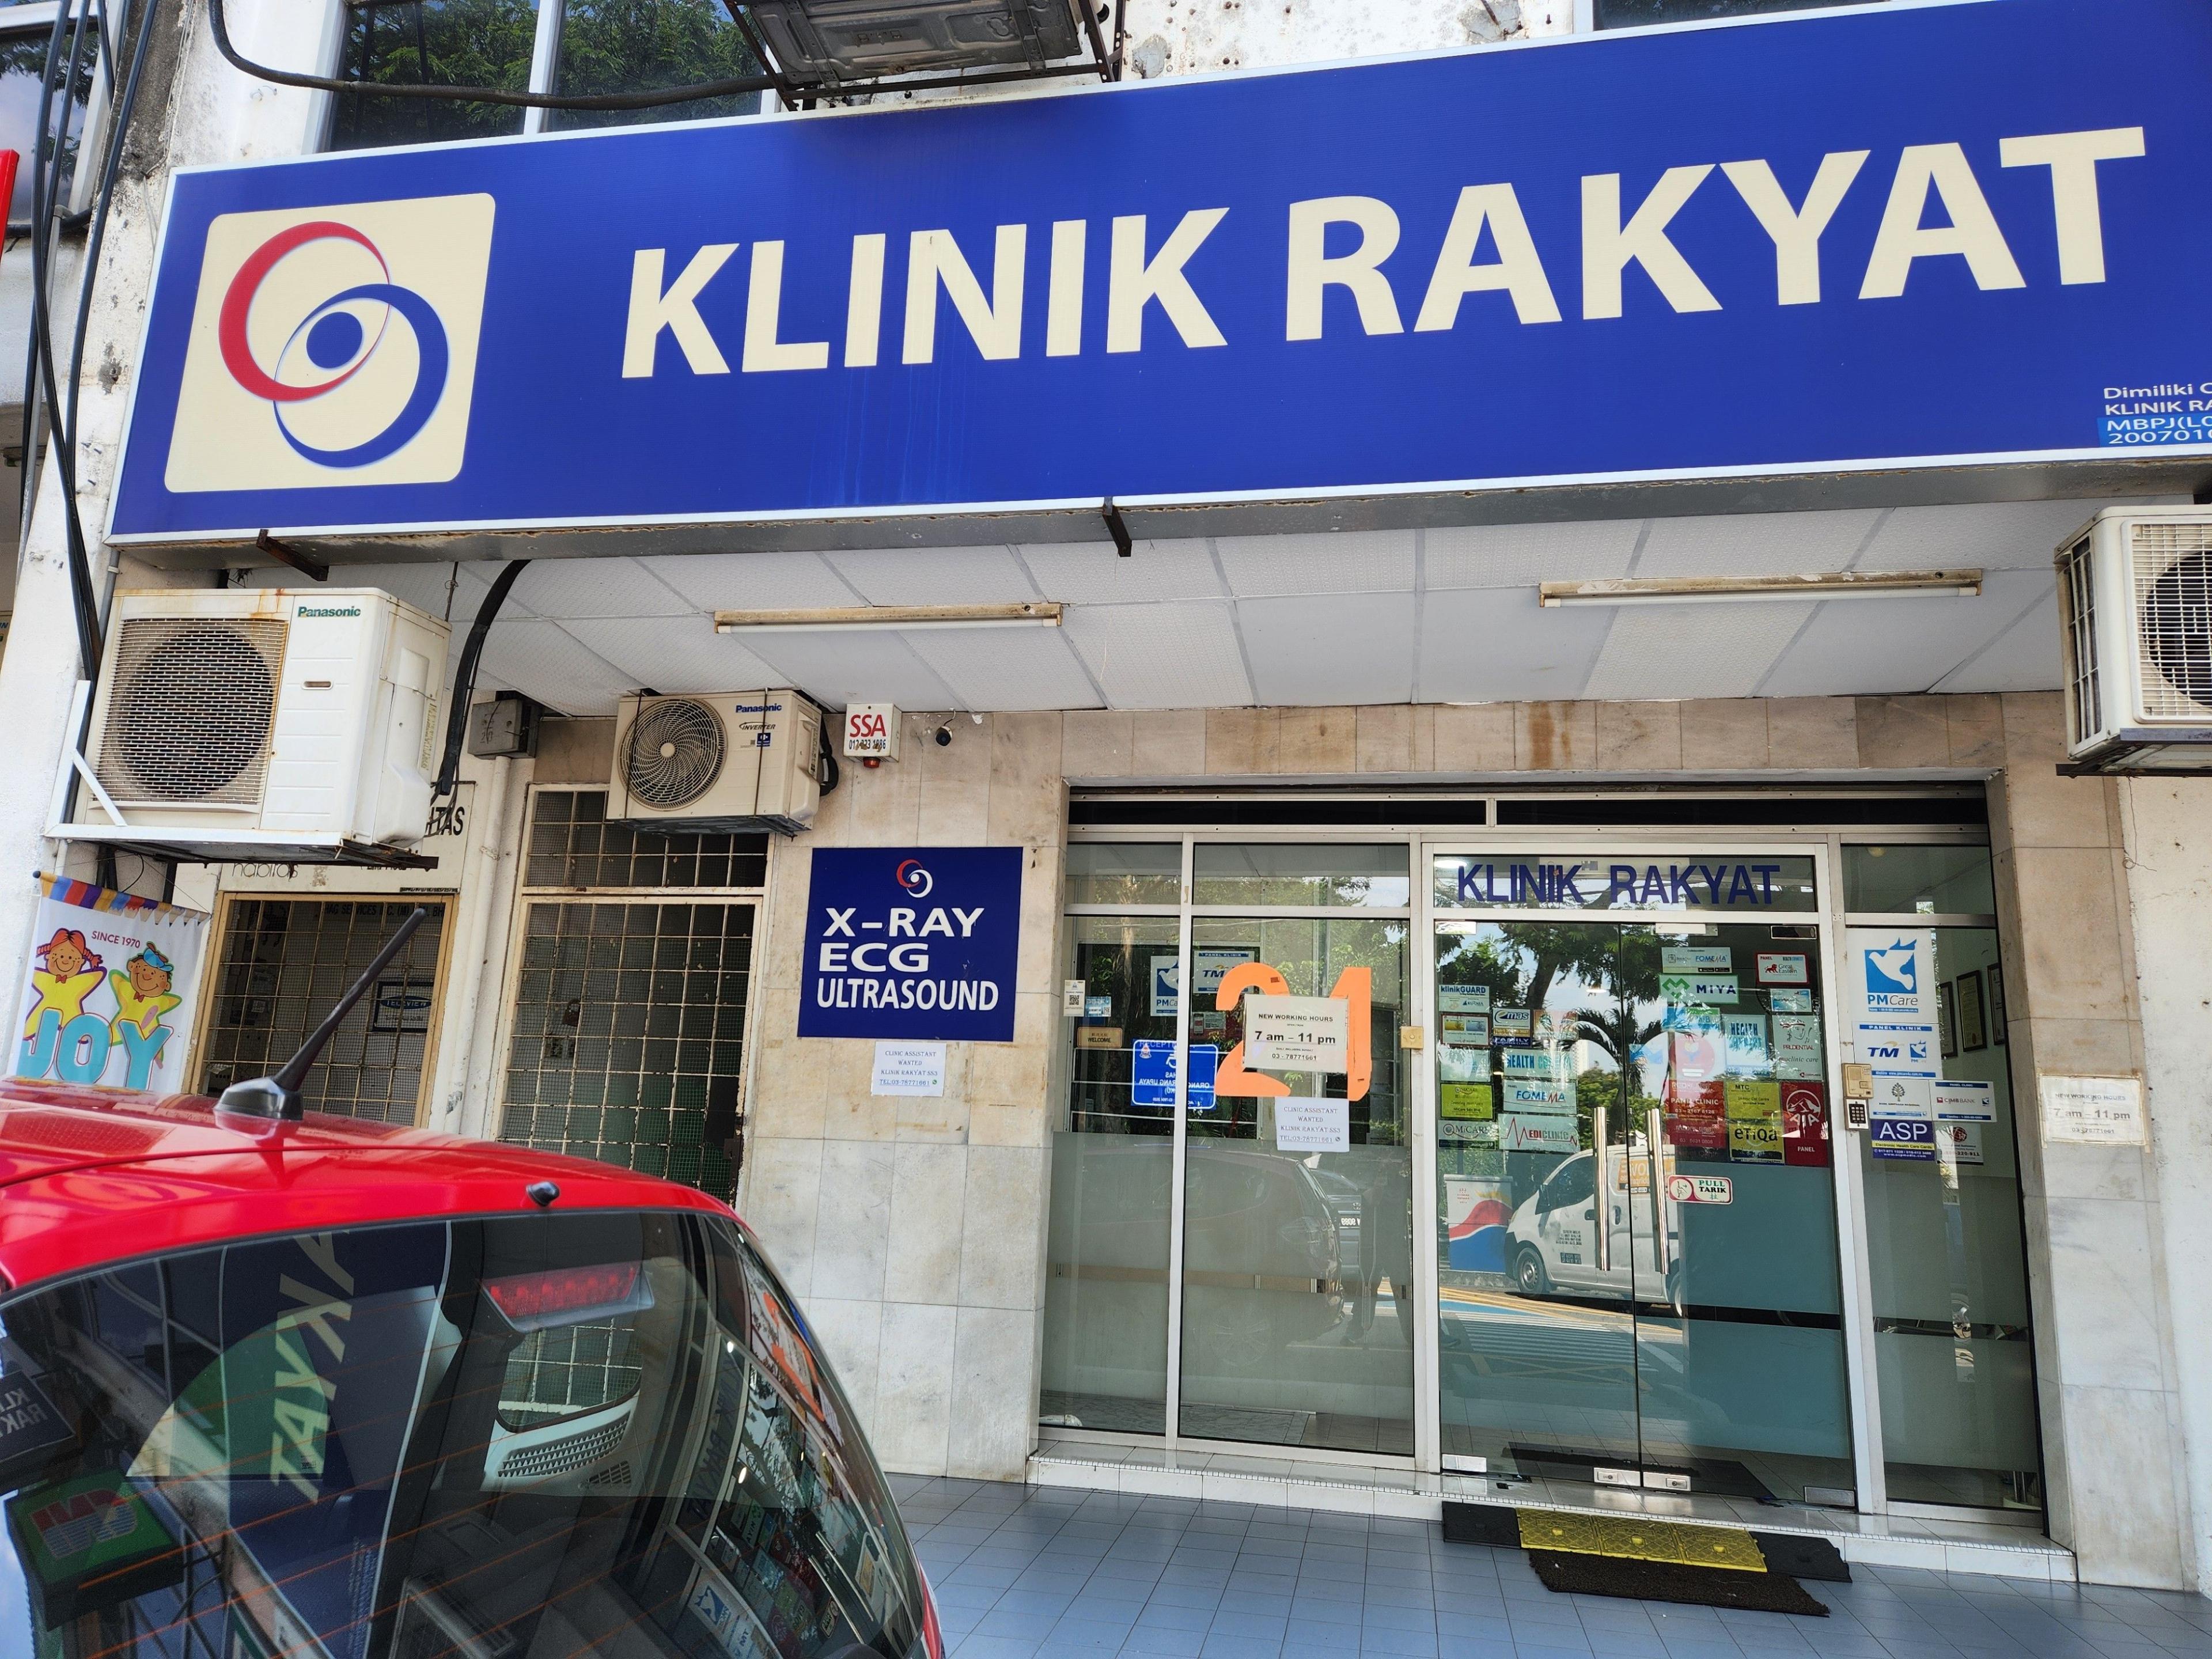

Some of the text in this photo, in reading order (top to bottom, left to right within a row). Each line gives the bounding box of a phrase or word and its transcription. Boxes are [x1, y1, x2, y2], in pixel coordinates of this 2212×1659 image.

[622, 127, 2145, 378] KLINIK RAKYAT
[2104, 384, 2193, 399] Dimiliki
[2105, 401, 2183, 415] KLINIK
[298, 605, 361, 617] Panasonic
[736, 703, 782, 713] Panasonic
[850, 714, 886, 737] SSA
[1459, 865, 1780, 904] KLINIK RAKYAT
[92, 930, 141, 949] SINCE 1970
[820, 943, 929, 972] ECG
[817, 978, 998, 1010] ULTRASOUND
[1868, 994, 1918, 1005] PMCare
[1156, 999, 1177, 1007] PMCa
[1255, 1031, 1262, 1040] 7
[1298, 1033, 1312, 1042] 11
[16, 1008, 174, 1090] JOY
[1868, 1047, 1899, 1058] TM
[1516, 1090, 1566, 1103] FOMEMA
[1790, 1113, 1820, 1127] AIA
[2054, 1108, 2061, 1116] 7
[2094, 1109, 2108, 1118] 11
[2113, 1112, 2130, 1120] pm
[1880, 1122, 1927, 1140] ASP
